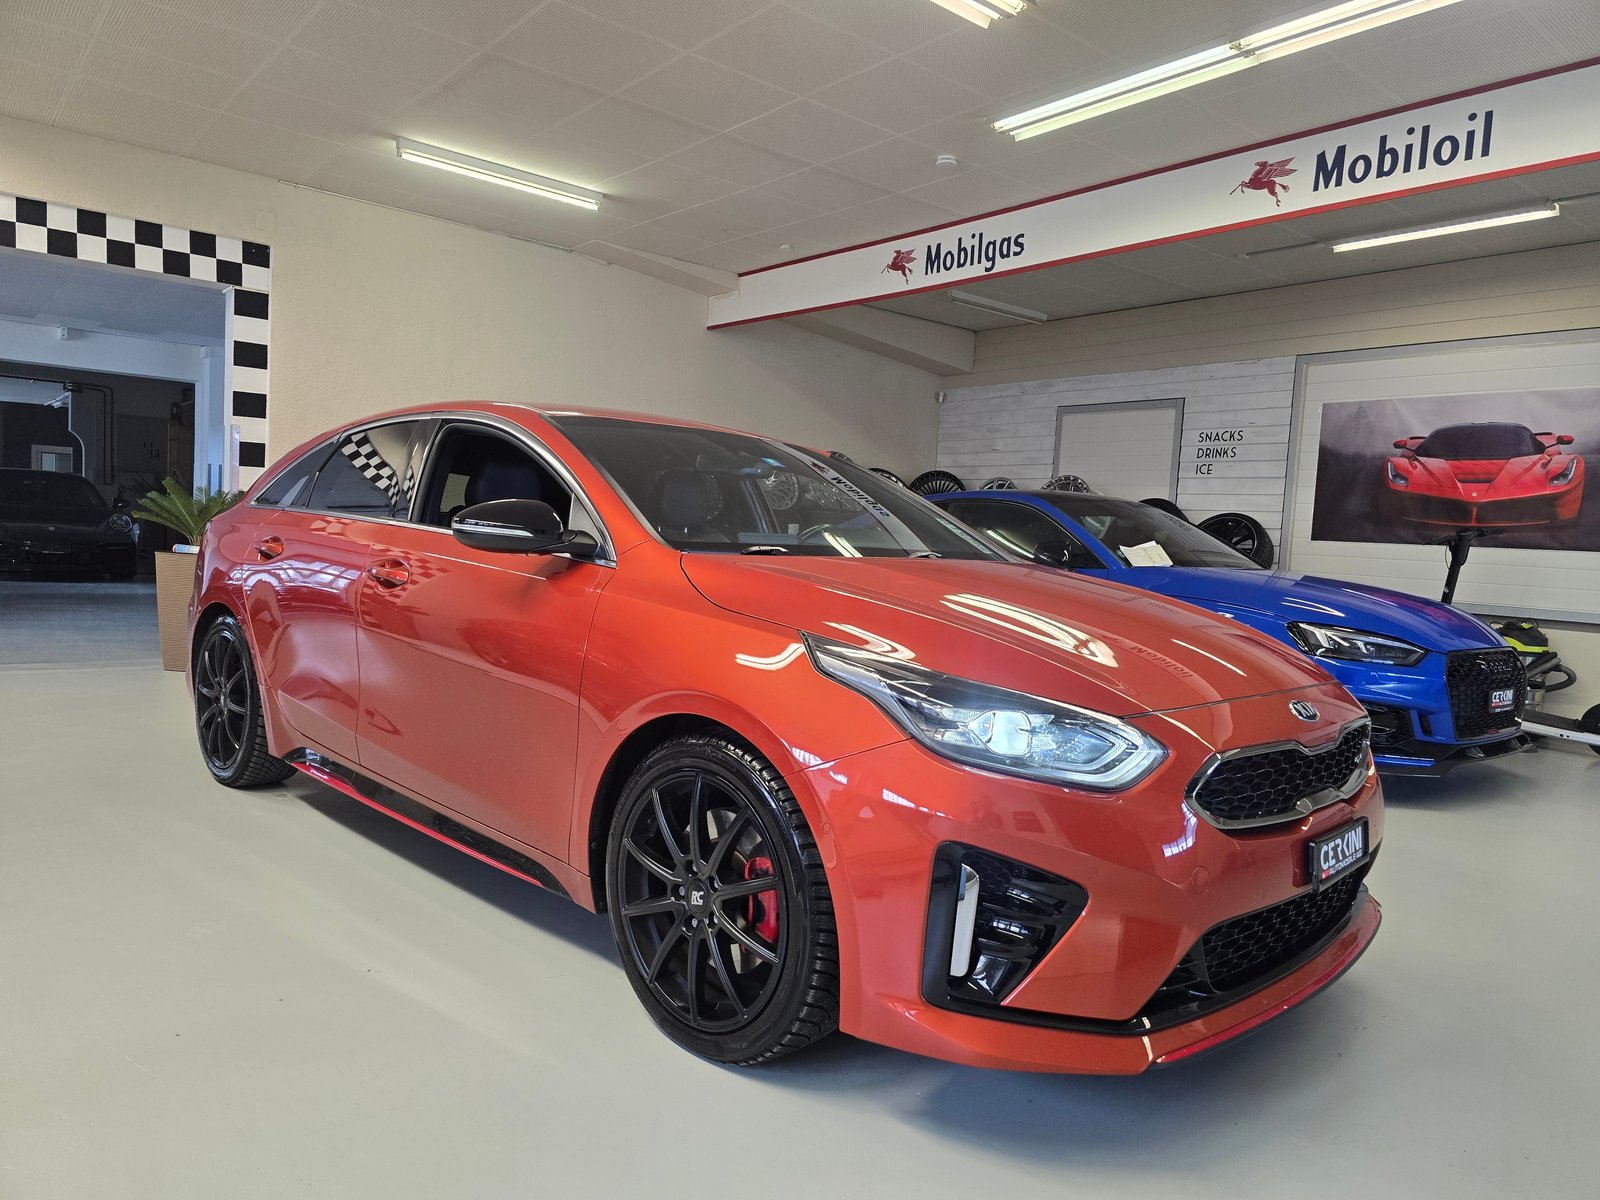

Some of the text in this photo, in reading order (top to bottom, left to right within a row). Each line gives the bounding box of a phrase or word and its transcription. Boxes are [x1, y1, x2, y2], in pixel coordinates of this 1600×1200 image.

[1312, 109, 1494, 193] Mobiloil
[924, 232, 1025, 276] Mobilgas
[1197, 430, 1244, 443] SNACKS
[1196, 446, 1237, 459] DRINKS
[1195, 463, 1213, 475] ICE
[1320, 826, 1362, 870] CERKINI
